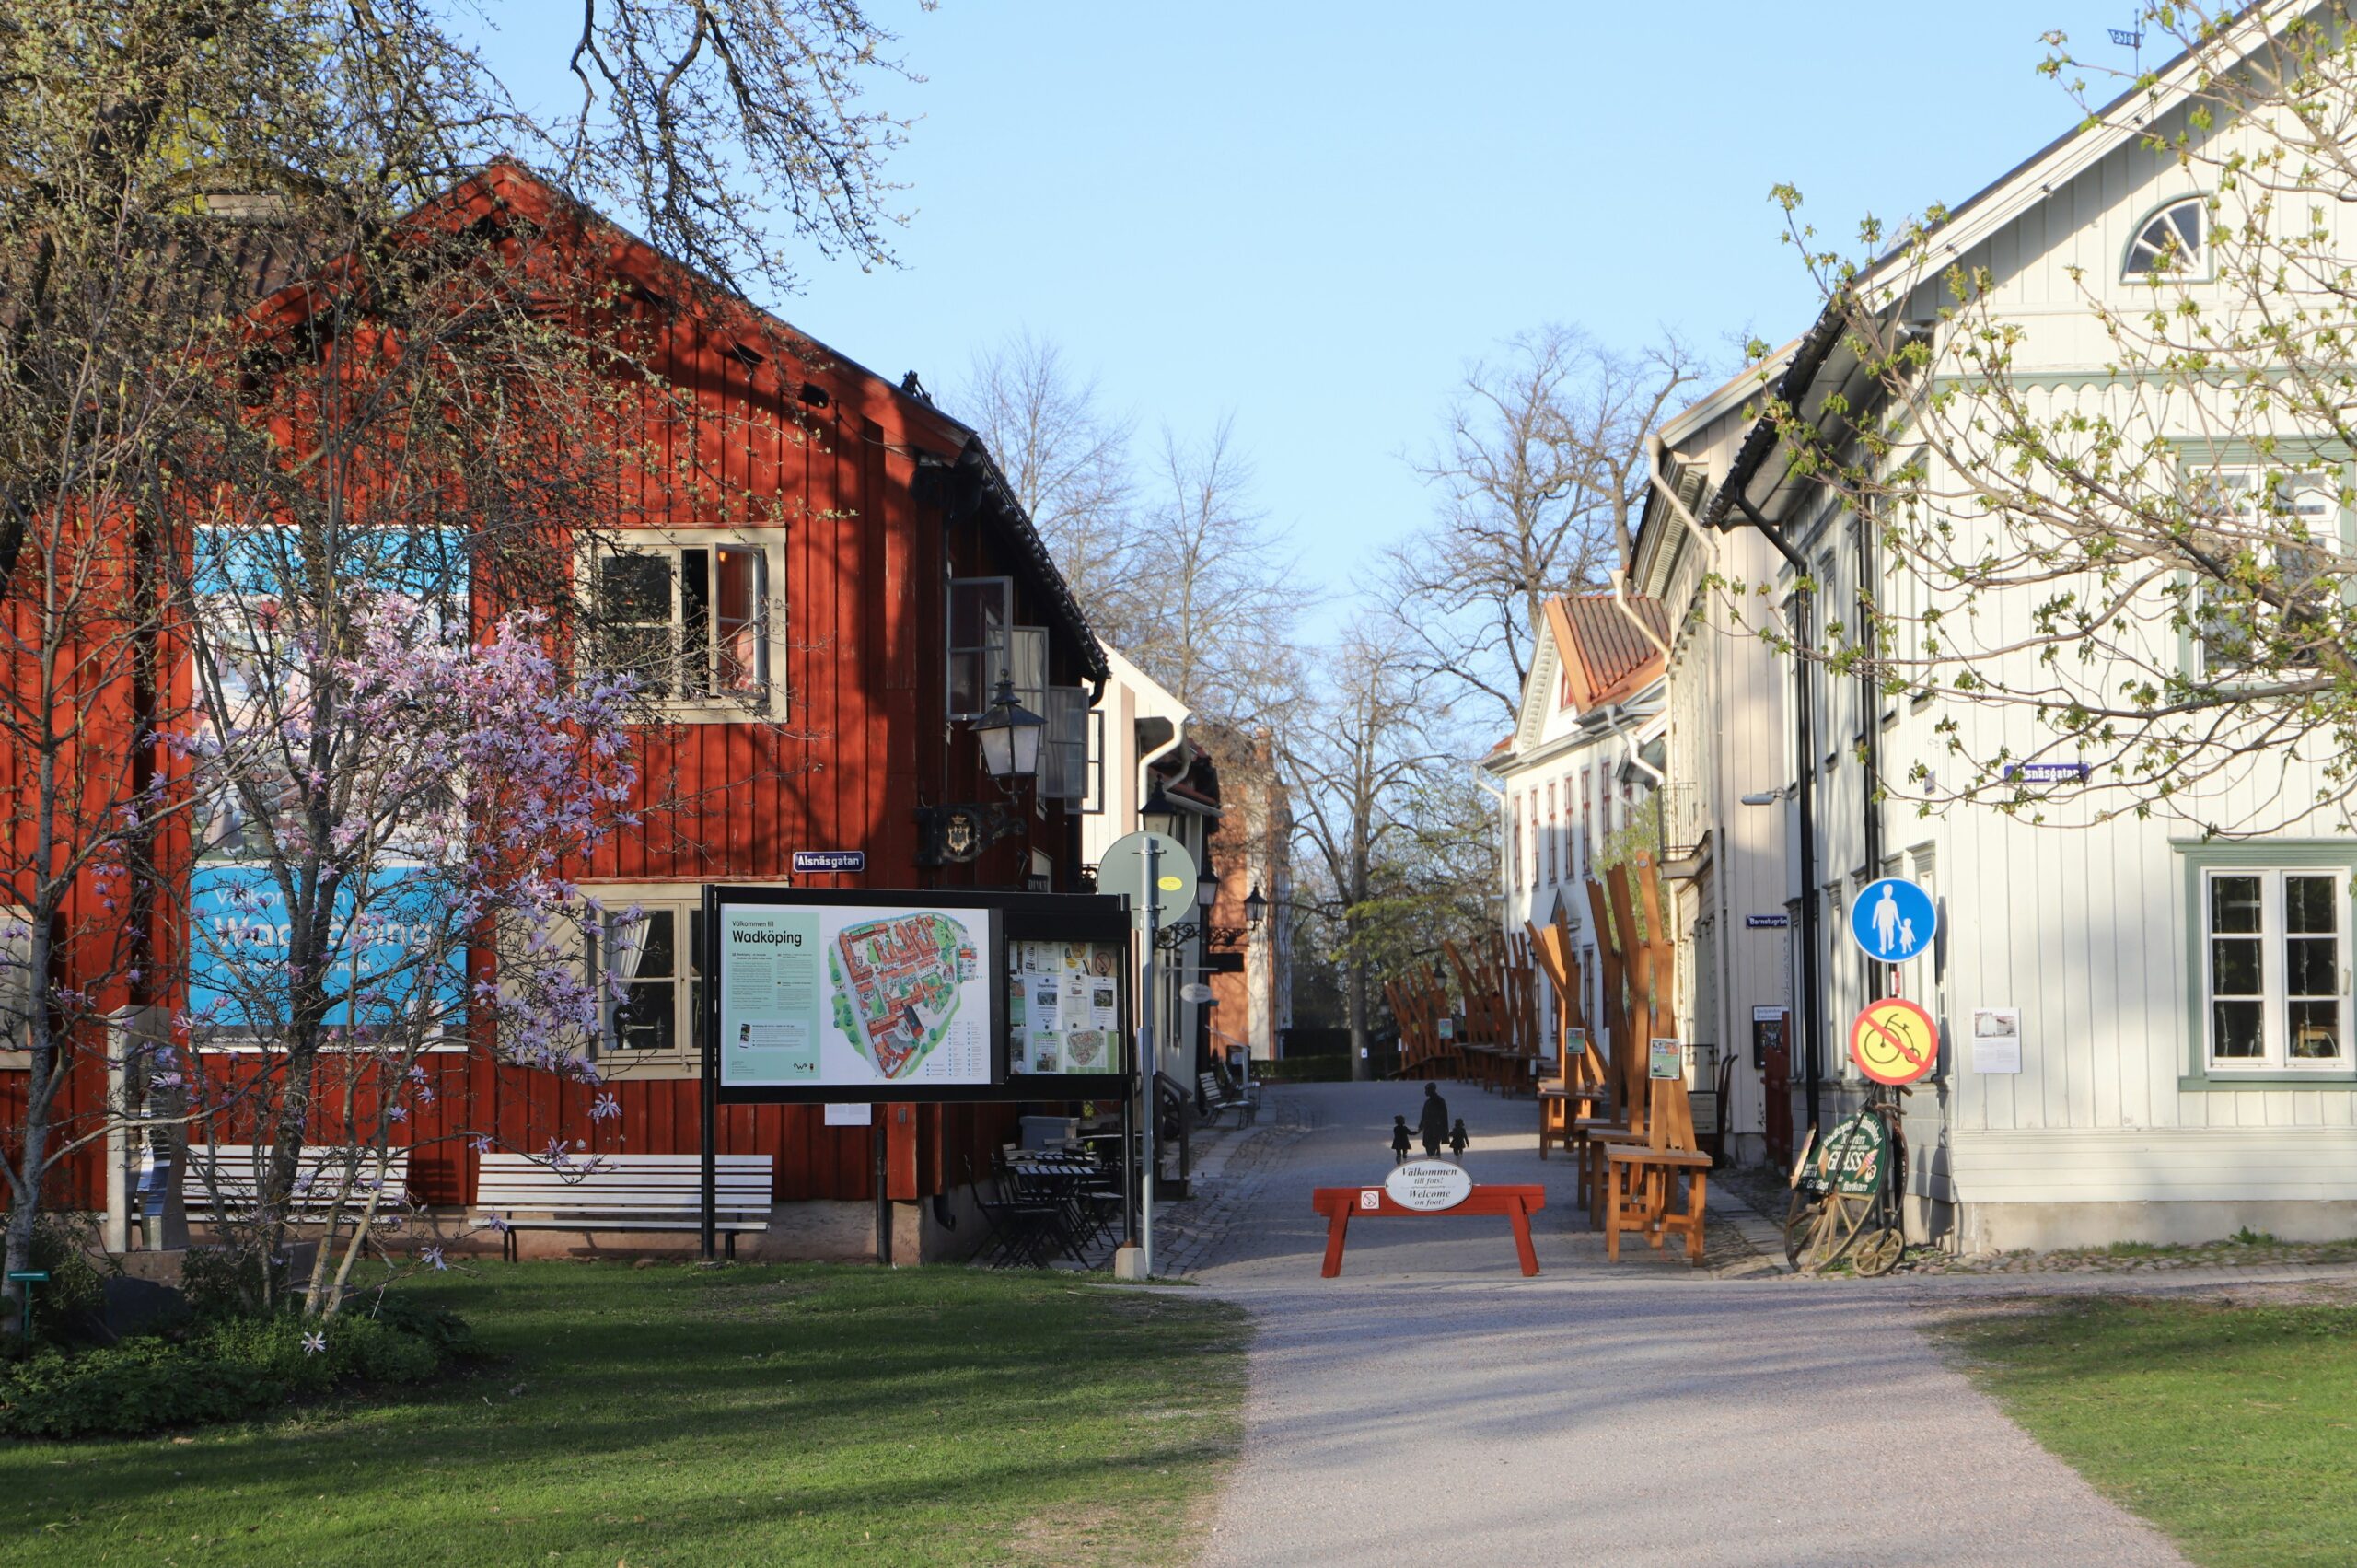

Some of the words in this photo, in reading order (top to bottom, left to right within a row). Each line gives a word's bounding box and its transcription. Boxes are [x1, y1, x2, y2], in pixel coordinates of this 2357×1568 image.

[2014, 766, 2080, 782] lsnäsgata
[797, 854, 860, 869] Alsnäsgatan
[731, 920, 767, 928] Välkommen
[732, 930, 802, 947] Wadköping
[1402, 1167, 1457, 1177] Välkommen
[1426, 1178, 1444, 1186] fots!
[1409, 1189, 1452, 1198] Welcome
[1426, 1199, 1445, 1207] foot!
